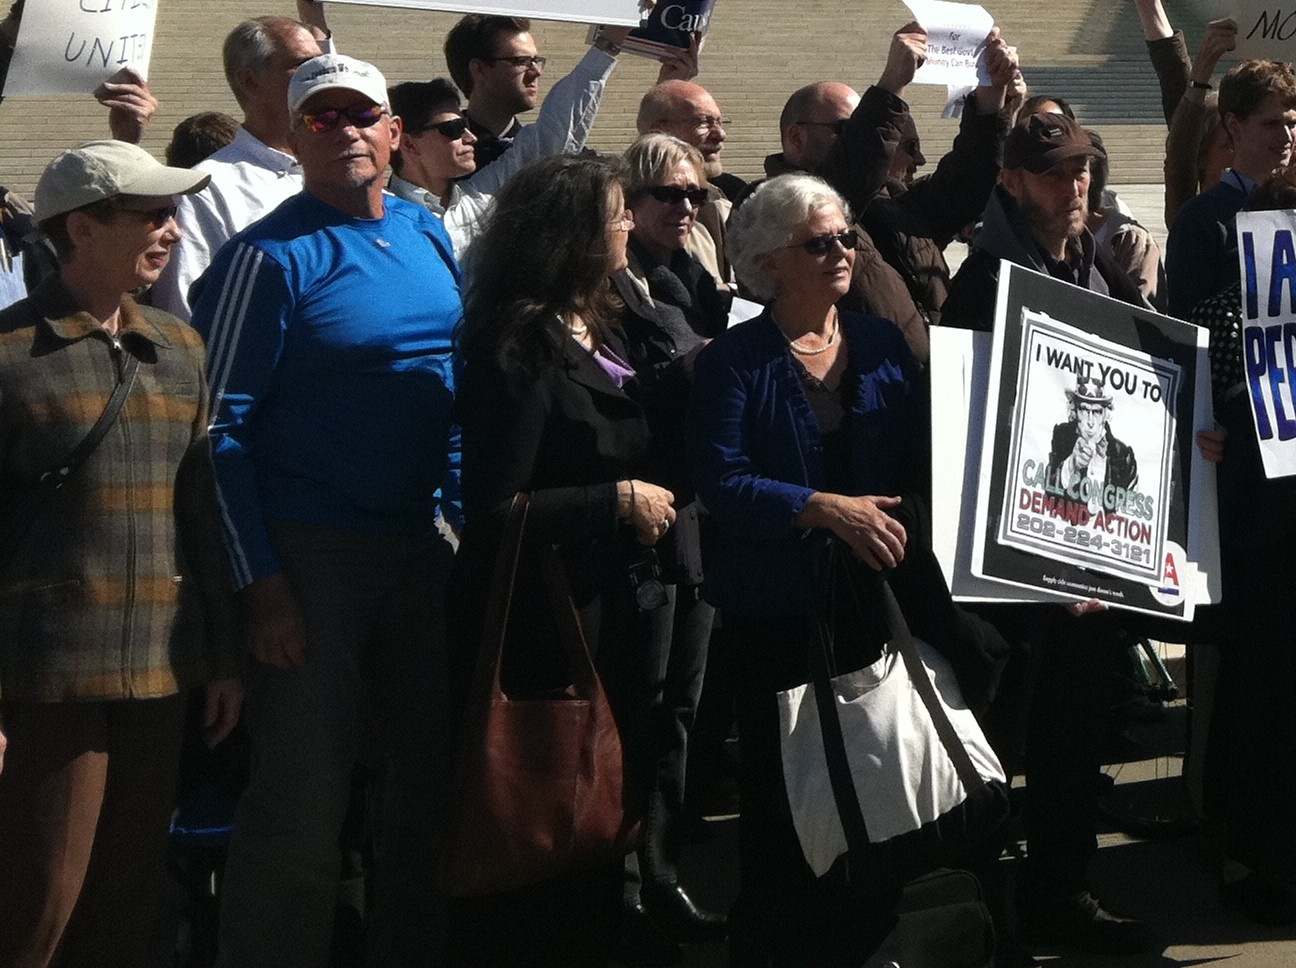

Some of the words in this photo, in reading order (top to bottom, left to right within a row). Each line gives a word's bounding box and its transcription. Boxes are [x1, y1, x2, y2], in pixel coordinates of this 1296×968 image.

[1242, 231, 1258, 319] I
[1036, 343, 1041, 362] I
[1046, 346, 1094, 379] WANT
[1098, 362, 1138, 395] YOU
[1142, 380, 1162, 403] TO
[1019, 488, 1091, 527] DEMAND
[1093, 510, 1152, 546] ACTION
[1022, 458, 1064, 496] CALL
[1066, 470, 1155, 521] CONGRESS
[1016, 513, 1152, 564] 202-224-3121
